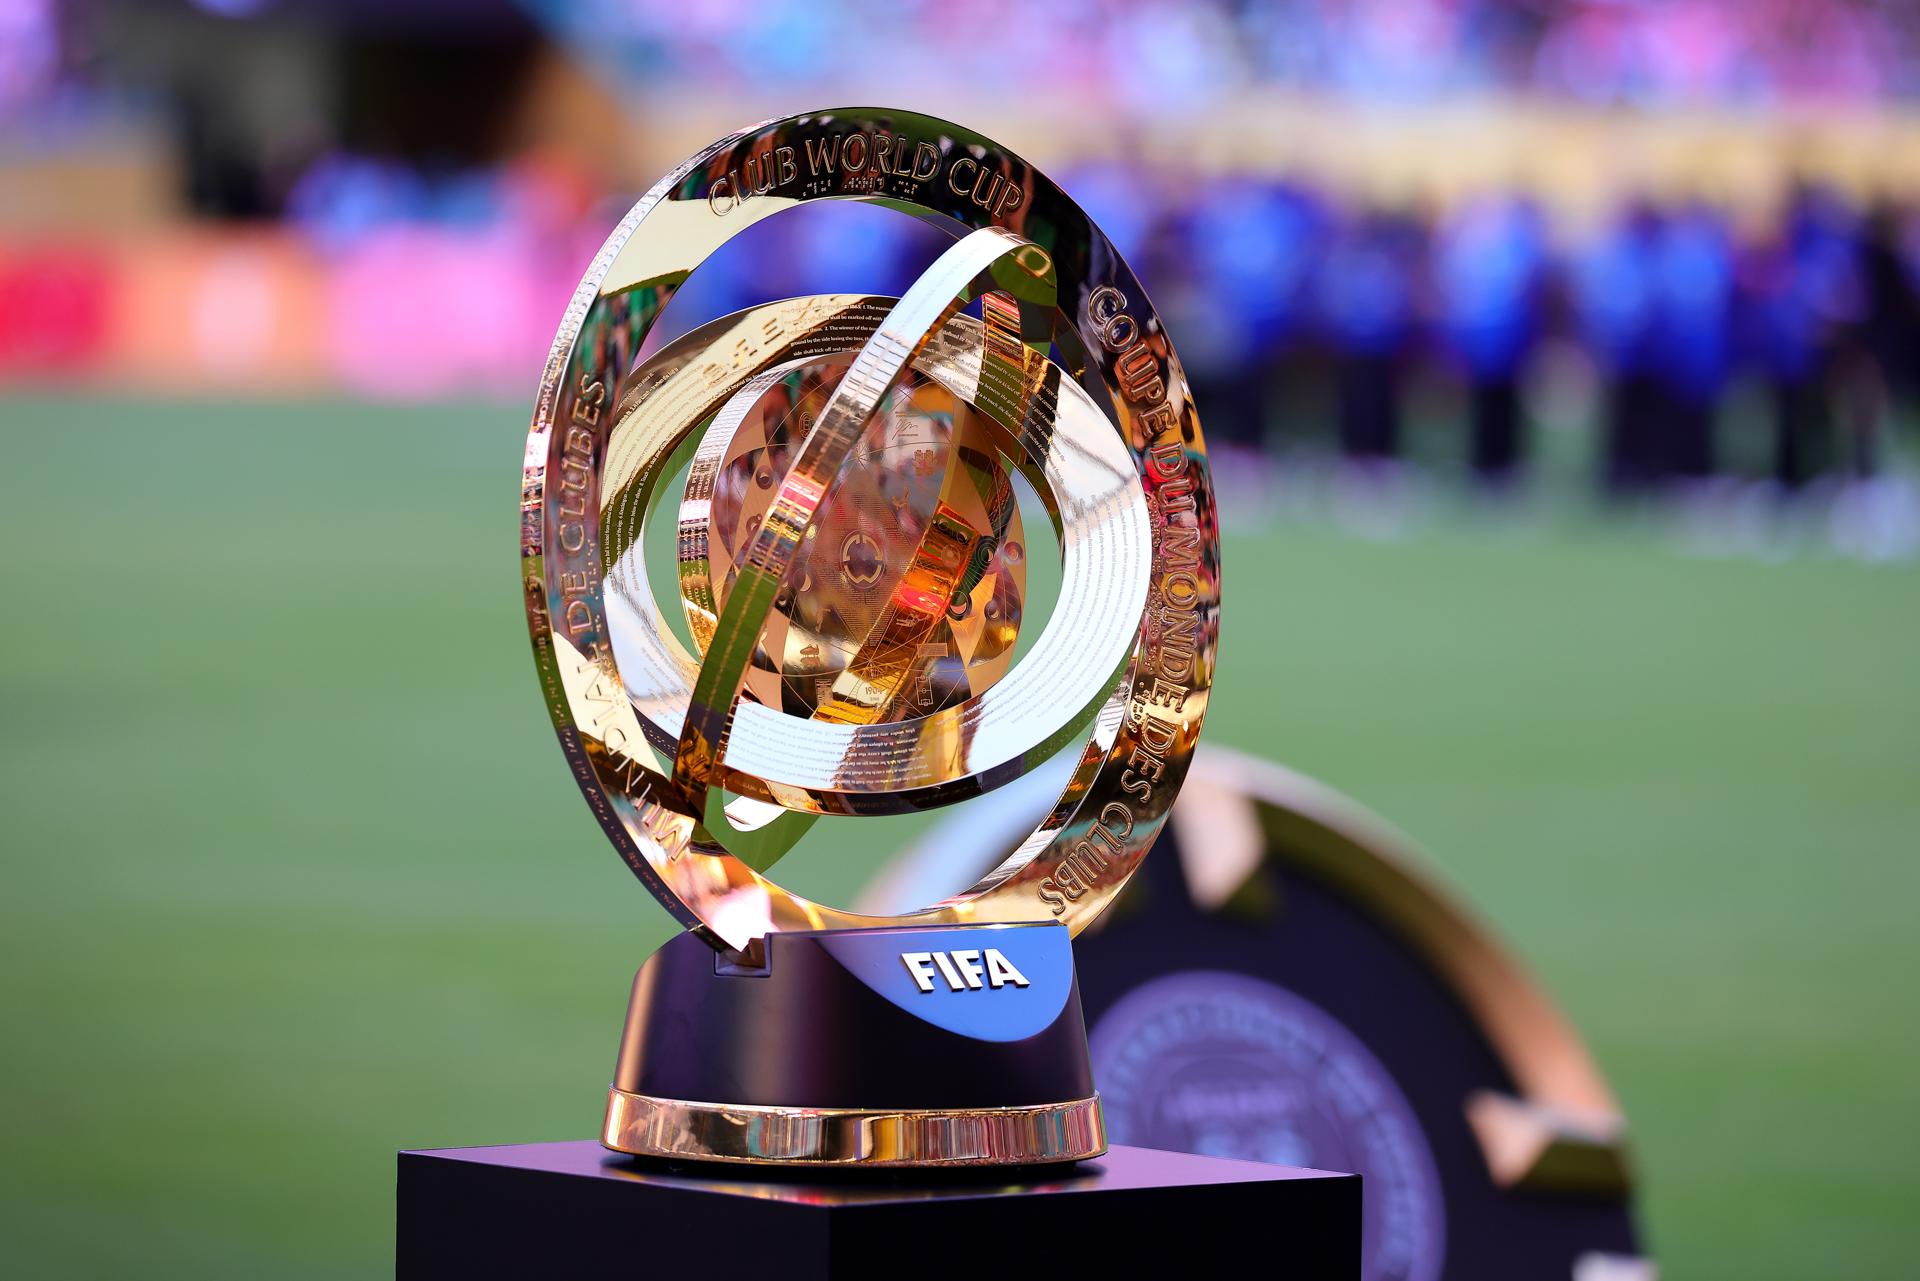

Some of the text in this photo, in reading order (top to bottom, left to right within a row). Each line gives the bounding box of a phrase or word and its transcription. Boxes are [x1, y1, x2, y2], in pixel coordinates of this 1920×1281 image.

[708, 132, 1025, 218] CLUB WORLD CUP
[560, 374, 606, 558] CLUBES
[560, 569, 594, 635] DE
[1037, 286, 1201, 915] COUPE DU MONDE DES CLUBS
[577, 641, 692, 862] MUNDIAL
[900, 948, 1031, 993] FIFA
